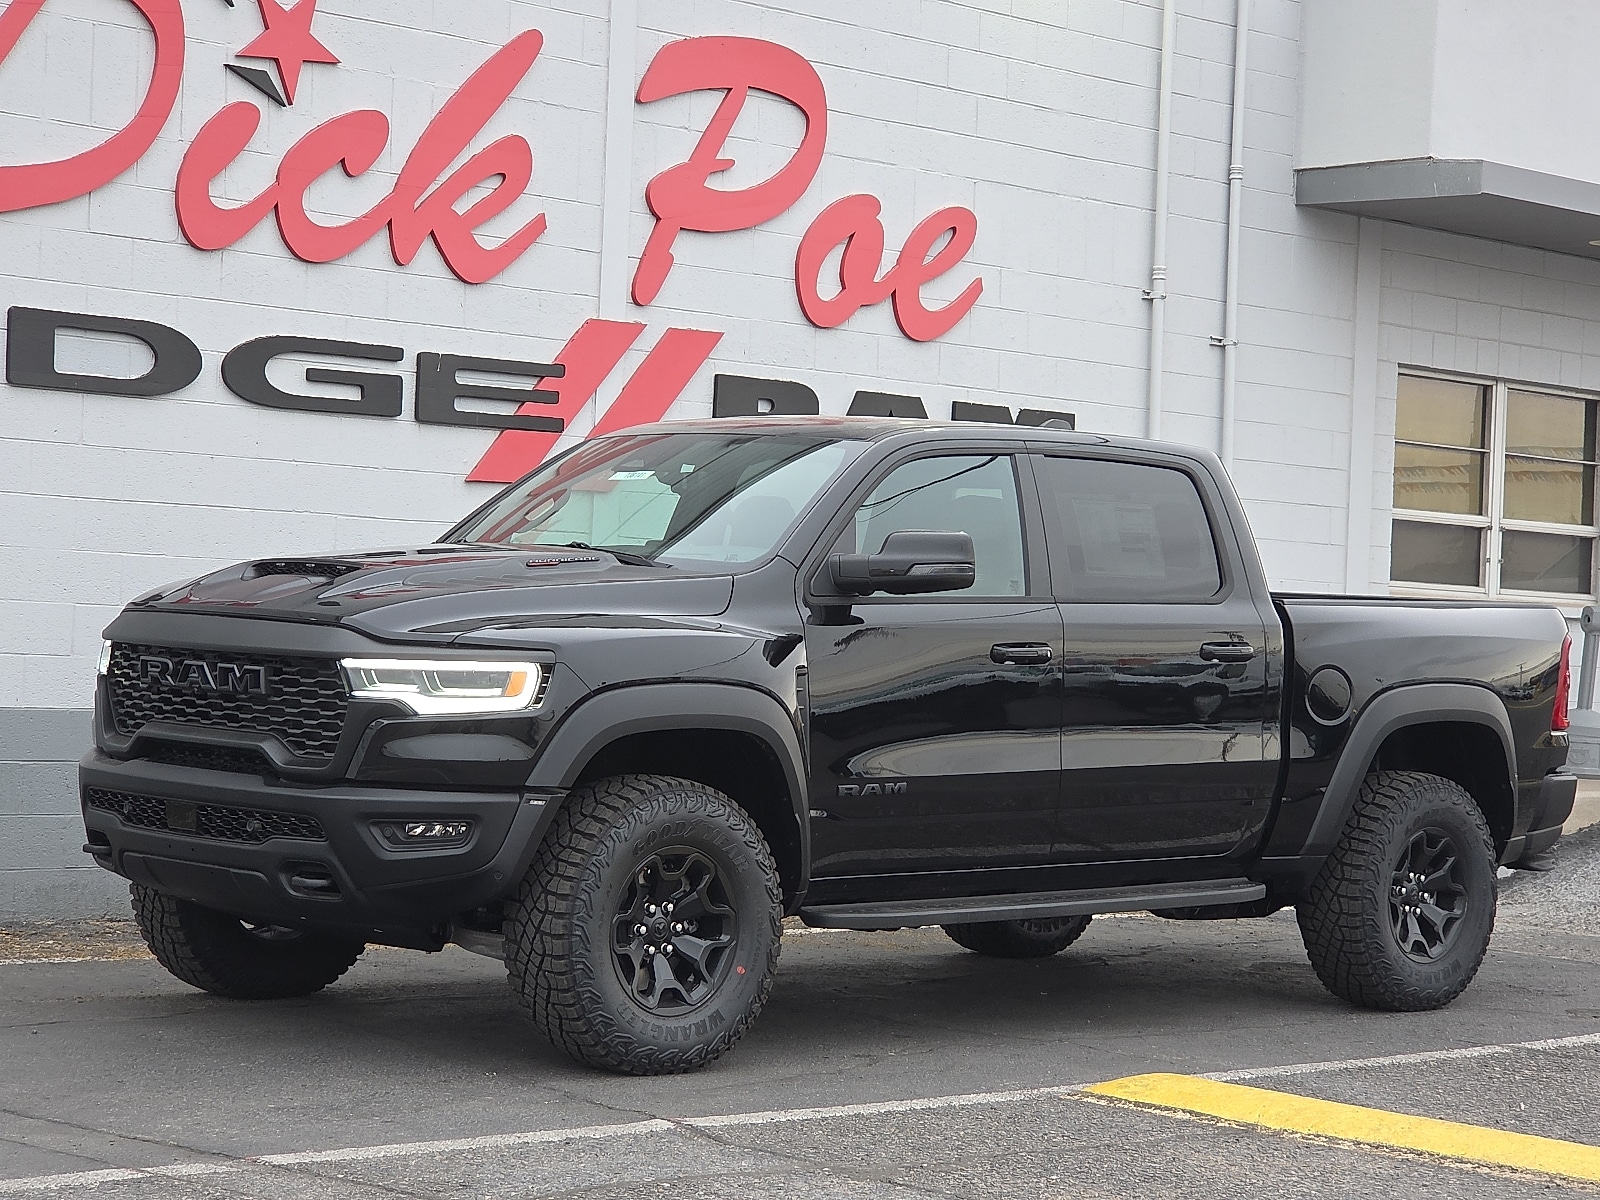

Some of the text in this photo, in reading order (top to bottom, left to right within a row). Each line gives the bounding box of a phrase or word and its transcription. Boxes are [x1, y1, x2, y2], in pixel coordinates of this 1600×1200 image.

[632, 36, 983, 342] Poe
[138, 655, 268, 695] RAM
[837, 781, 908, 797] RAM
[632, 817, 750, 873] GOODYEAR
[616, 1001, 726, 1042] WRANGLER
